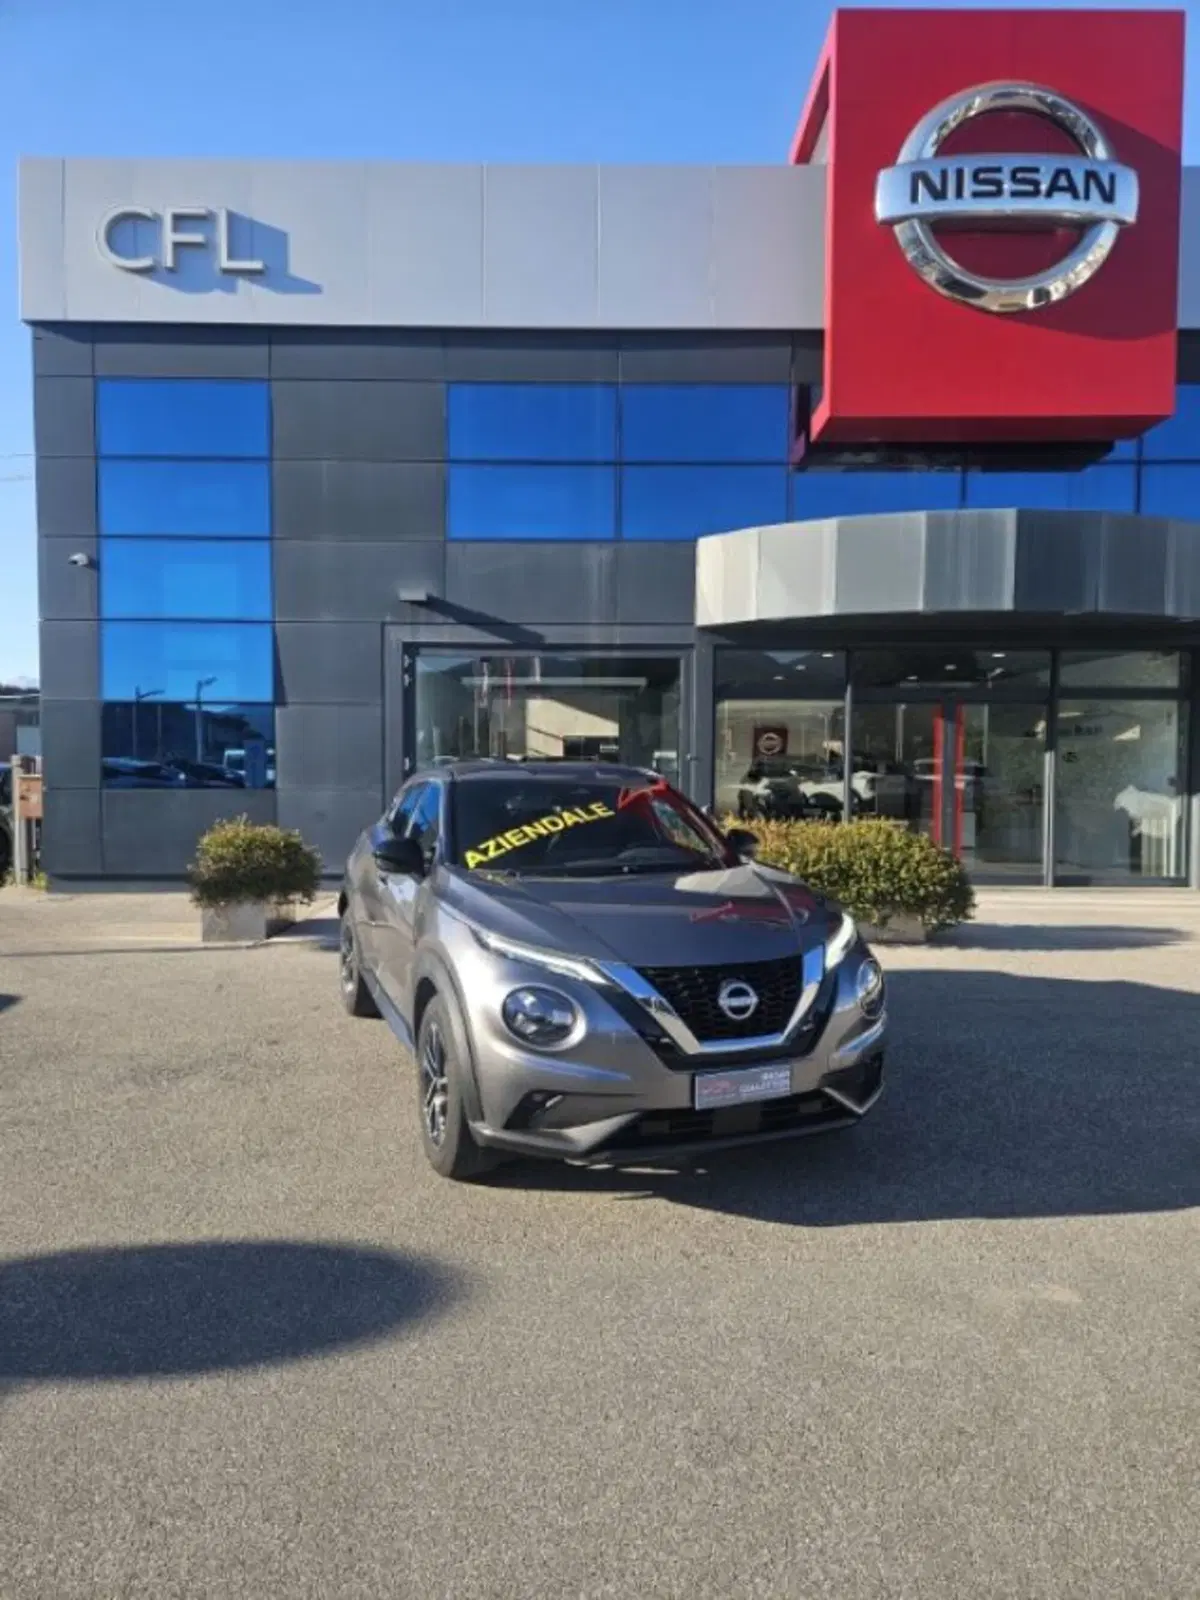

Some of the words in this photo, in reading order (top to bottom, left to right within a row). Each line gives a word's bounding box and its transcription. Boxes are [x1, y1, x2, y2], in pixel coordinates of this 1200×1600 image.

[909, 166, 1115, 204] NISSAN
[98, 206, 264, 272] CFL
[463, 801, 616, 870] AZIENDALE
